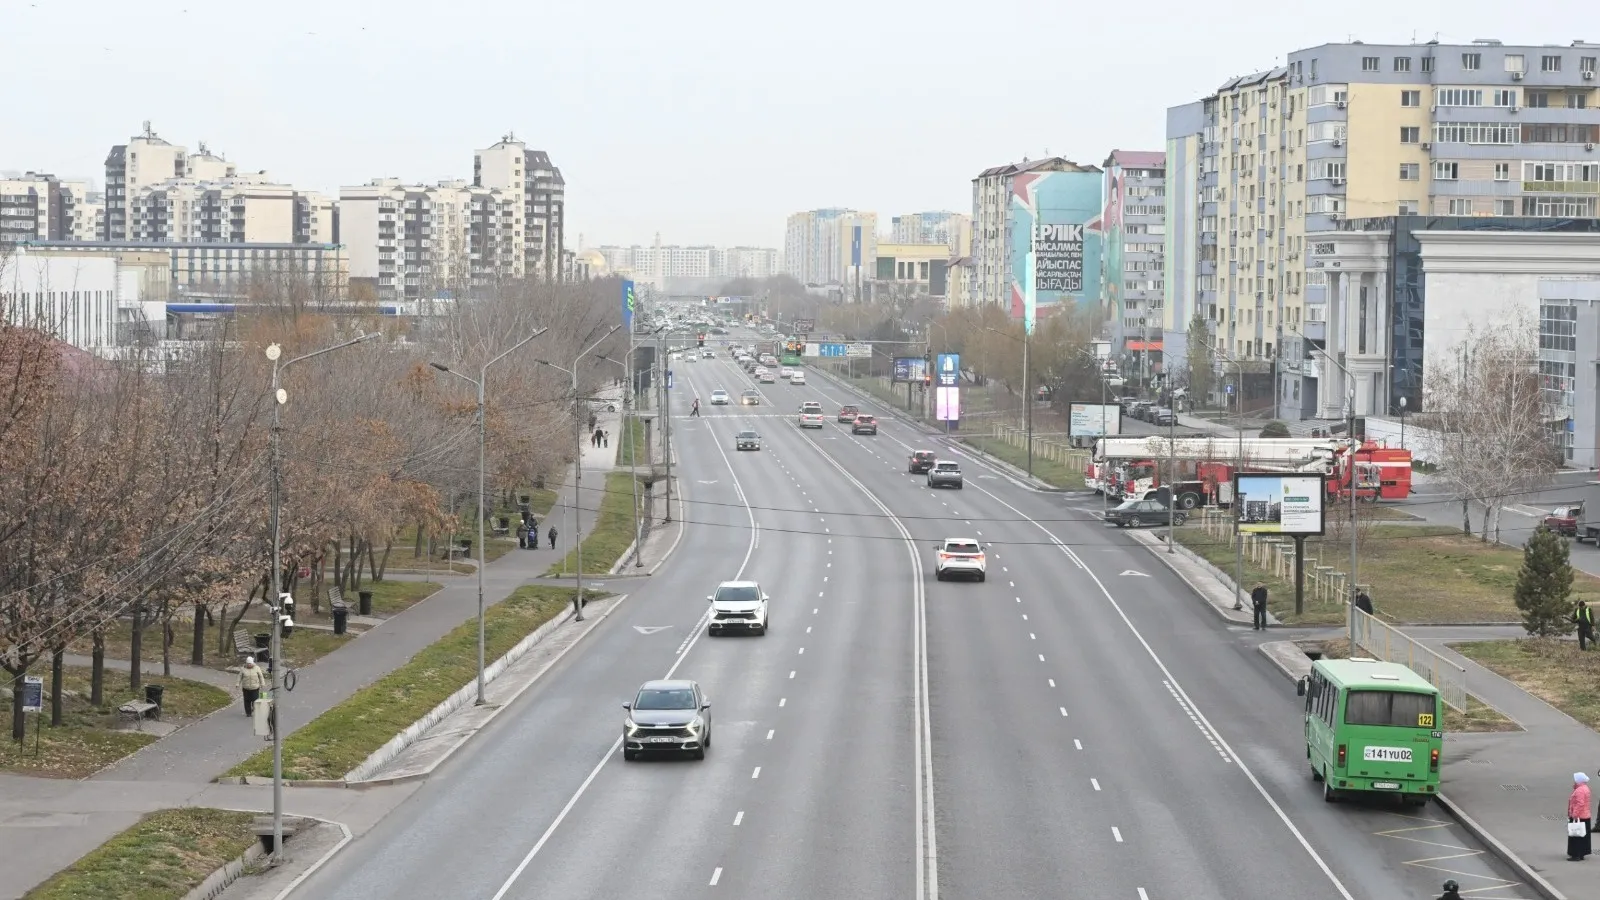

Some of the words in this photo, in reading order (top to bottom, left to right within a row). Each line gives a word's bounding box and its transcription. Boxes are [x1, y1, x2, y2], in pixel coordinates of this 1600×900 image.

[1032, 241, 1082, 251] АЙСАЛМАС
[1036, 258, 1081, 269] АЙЫСПАС
[1036, 270, 1082, 278] АЙСАРЛЫҚТАН
[1419, 716, 1432, 725] 122
